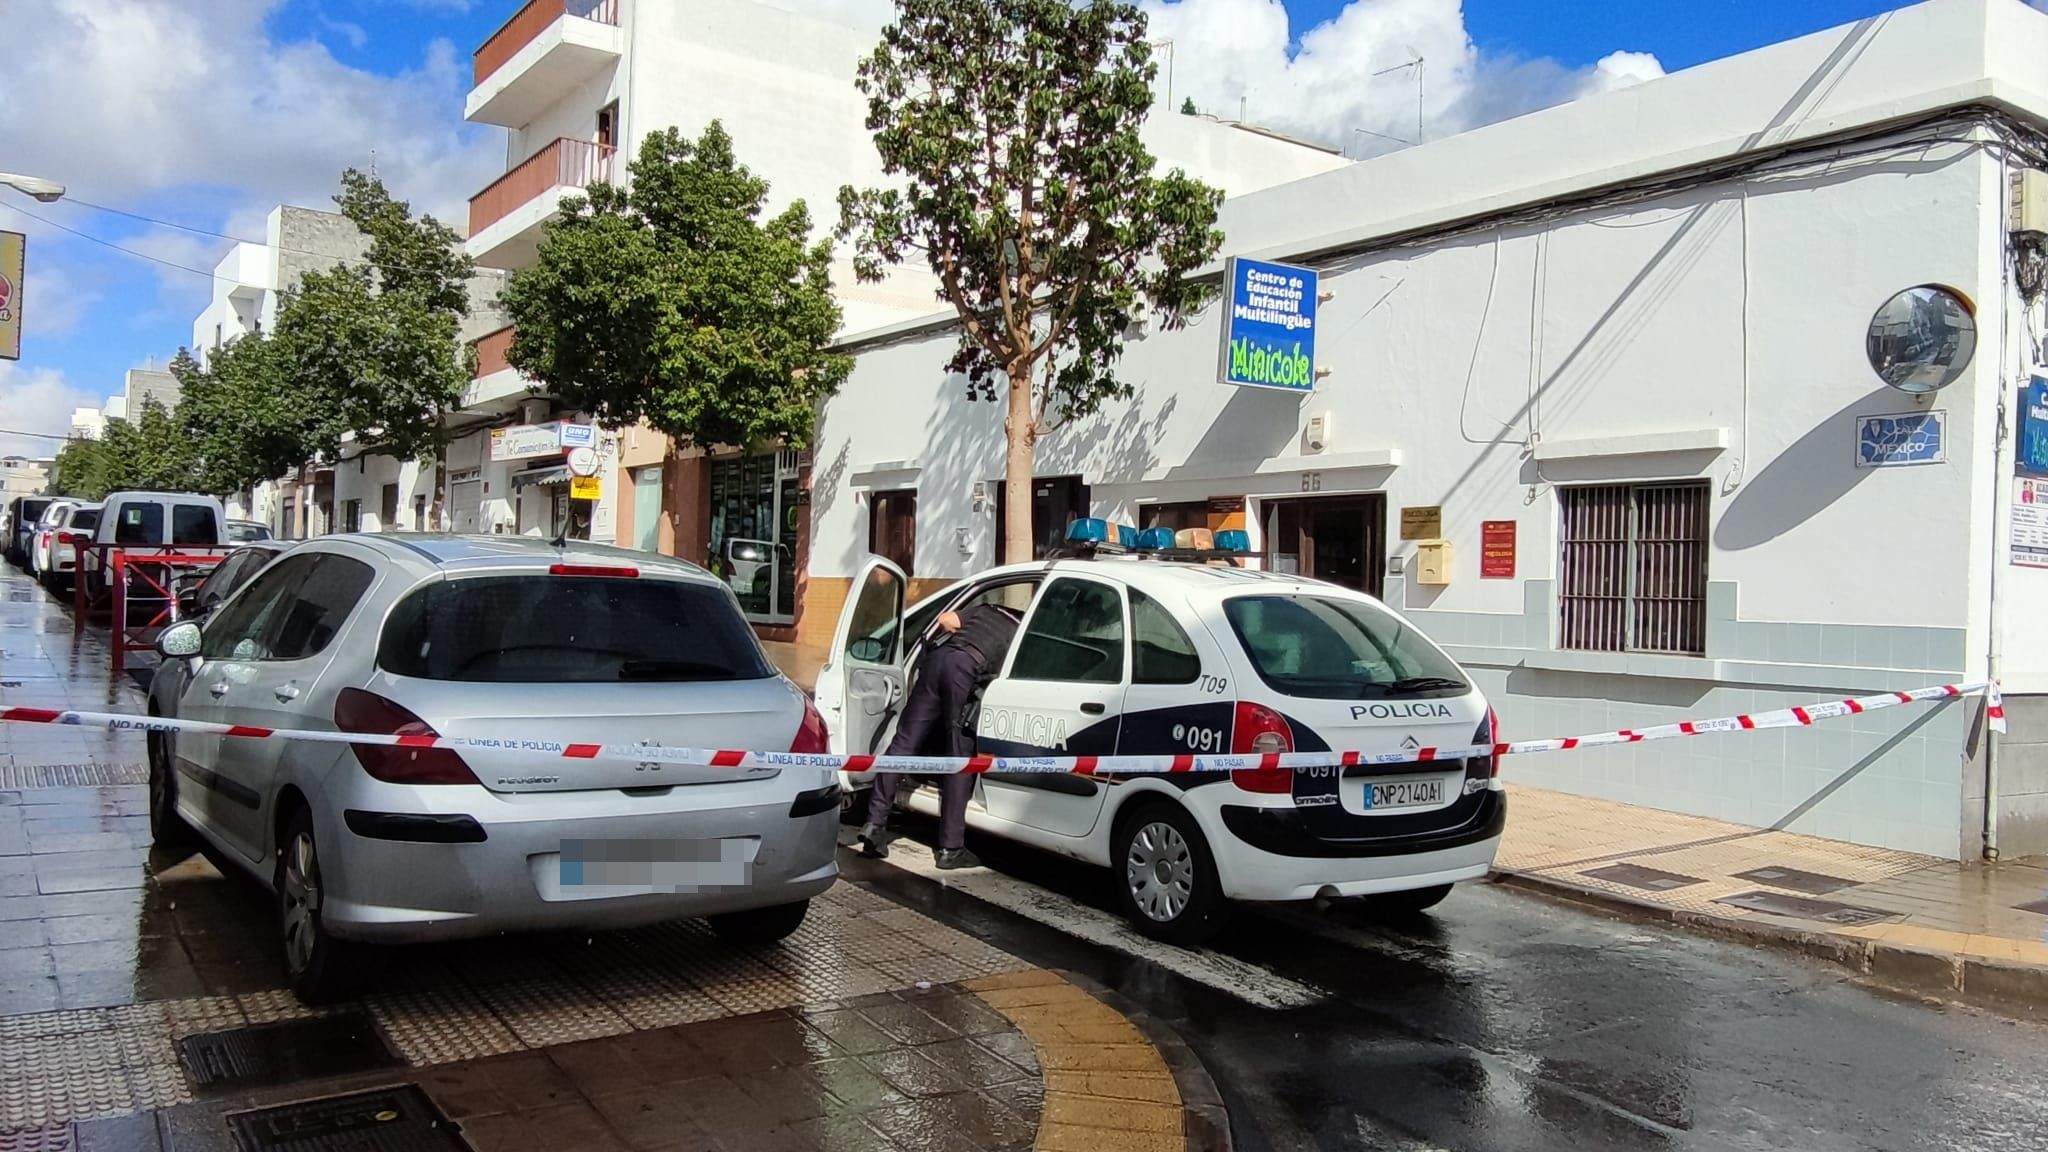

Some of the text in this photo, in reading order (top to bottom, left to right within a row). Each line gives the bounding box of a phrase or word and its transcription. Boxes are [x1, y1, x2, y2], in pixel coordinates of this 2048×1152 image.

[1247, 269, 1303, 289] Centro de
[1246, 281, 1302, 300] Educación
[1249, 293, 1299, 313] Infantil
[1234, 305, 1312, 330] Multilingüe
[1231, 336, 1311, 386] Minicole
[1200, 674, 1227, 695] T09
[1349, 703, 1453, 721] POLICIA
[109, 719, 130, 729] NO
[981, 707, 1068, 752] POLICIA
[504, 740, 518, 749] DE
[1187, 726, 1223, 754] 091
[767, 753, 842, 768] LINEA DE POLICIA
[497, 776, 561, 785] PEUGEOT
